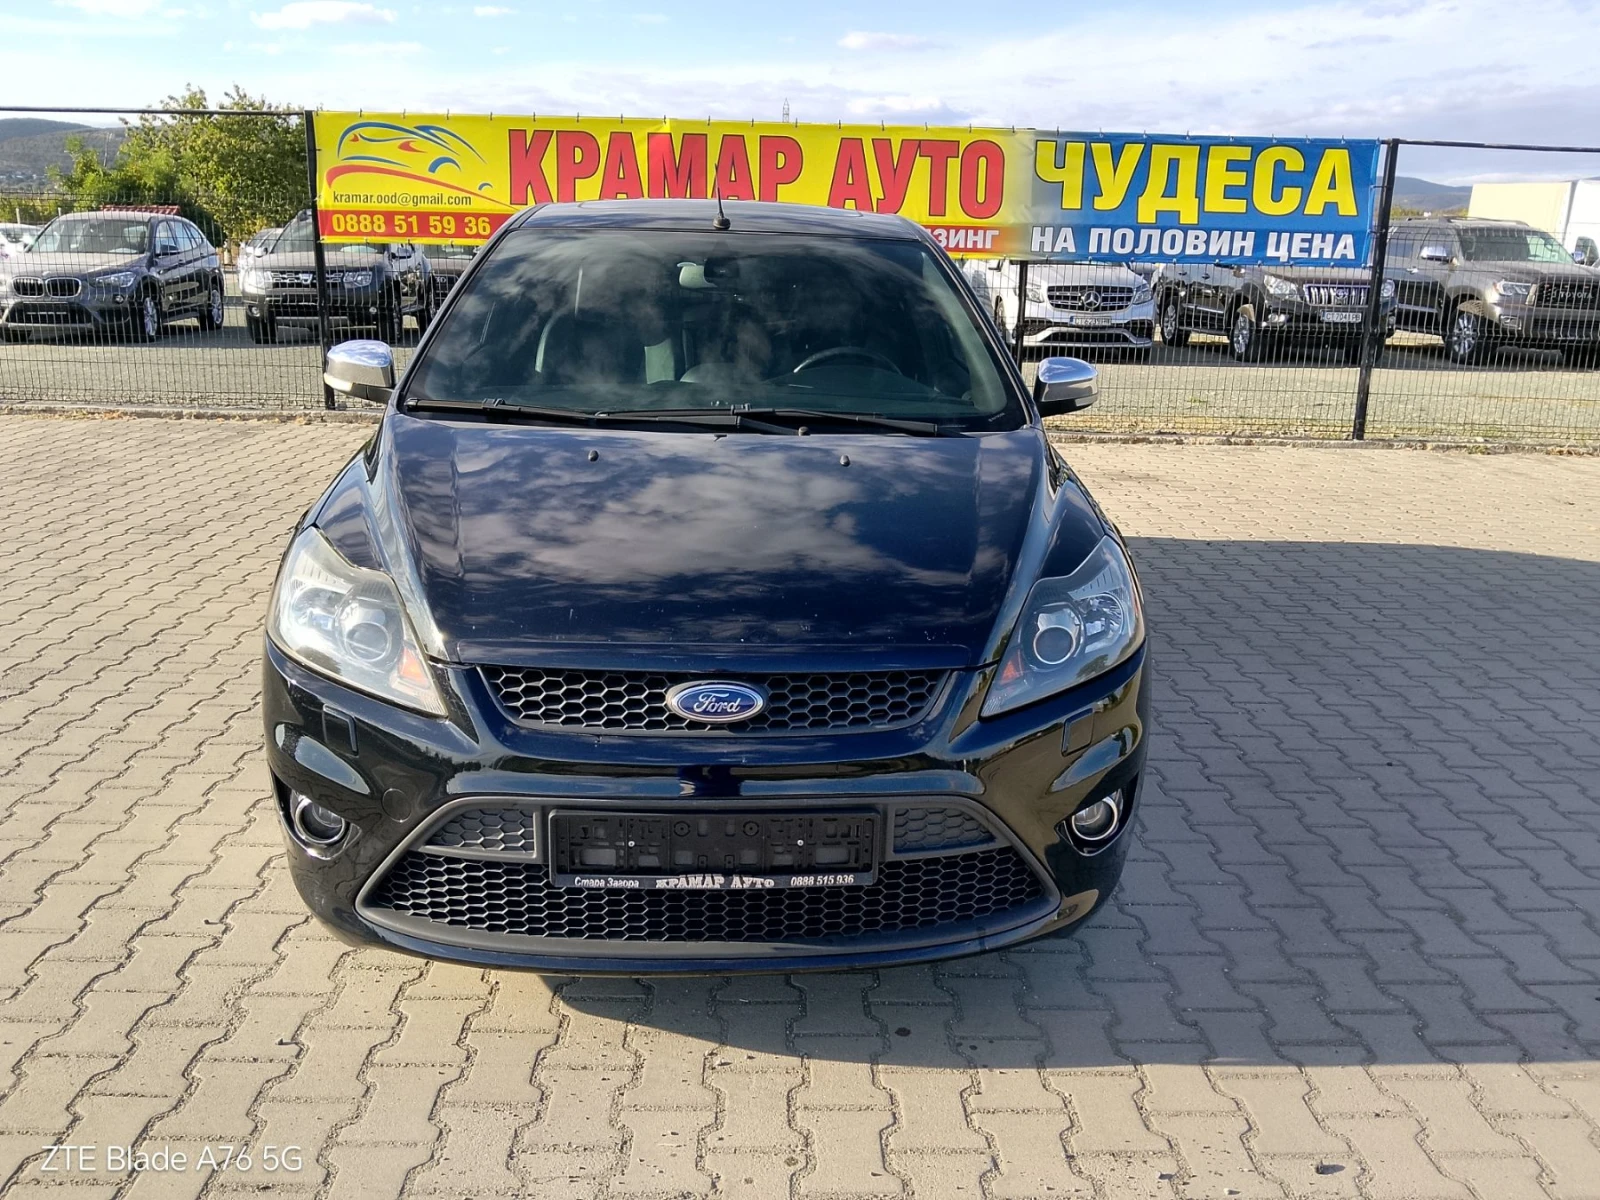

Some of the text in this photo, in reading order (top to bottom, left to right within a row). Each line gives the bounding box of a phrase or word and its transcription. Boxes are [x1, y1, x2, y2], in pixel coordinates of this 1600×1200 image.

[508, 128, 1005, 219] КРАМАР АУТО
[1034, 140, 1358, 225] ЧУДЕСА
[333, 191, 472, 207] kramar.ood@gmail.com
[332, 213, 491, 236] 0888 51 59 36
[925, 228, 1000, 249] ЗИНГ
[1031, 226, 1356, 262] НА ПОЛОВИН ЦЕНА
[693, 692, 741, 713] Ford
[656, 874, 775, 889] КРАМАР АУТО
[790, 874, 854, 887] 0888 515 936
